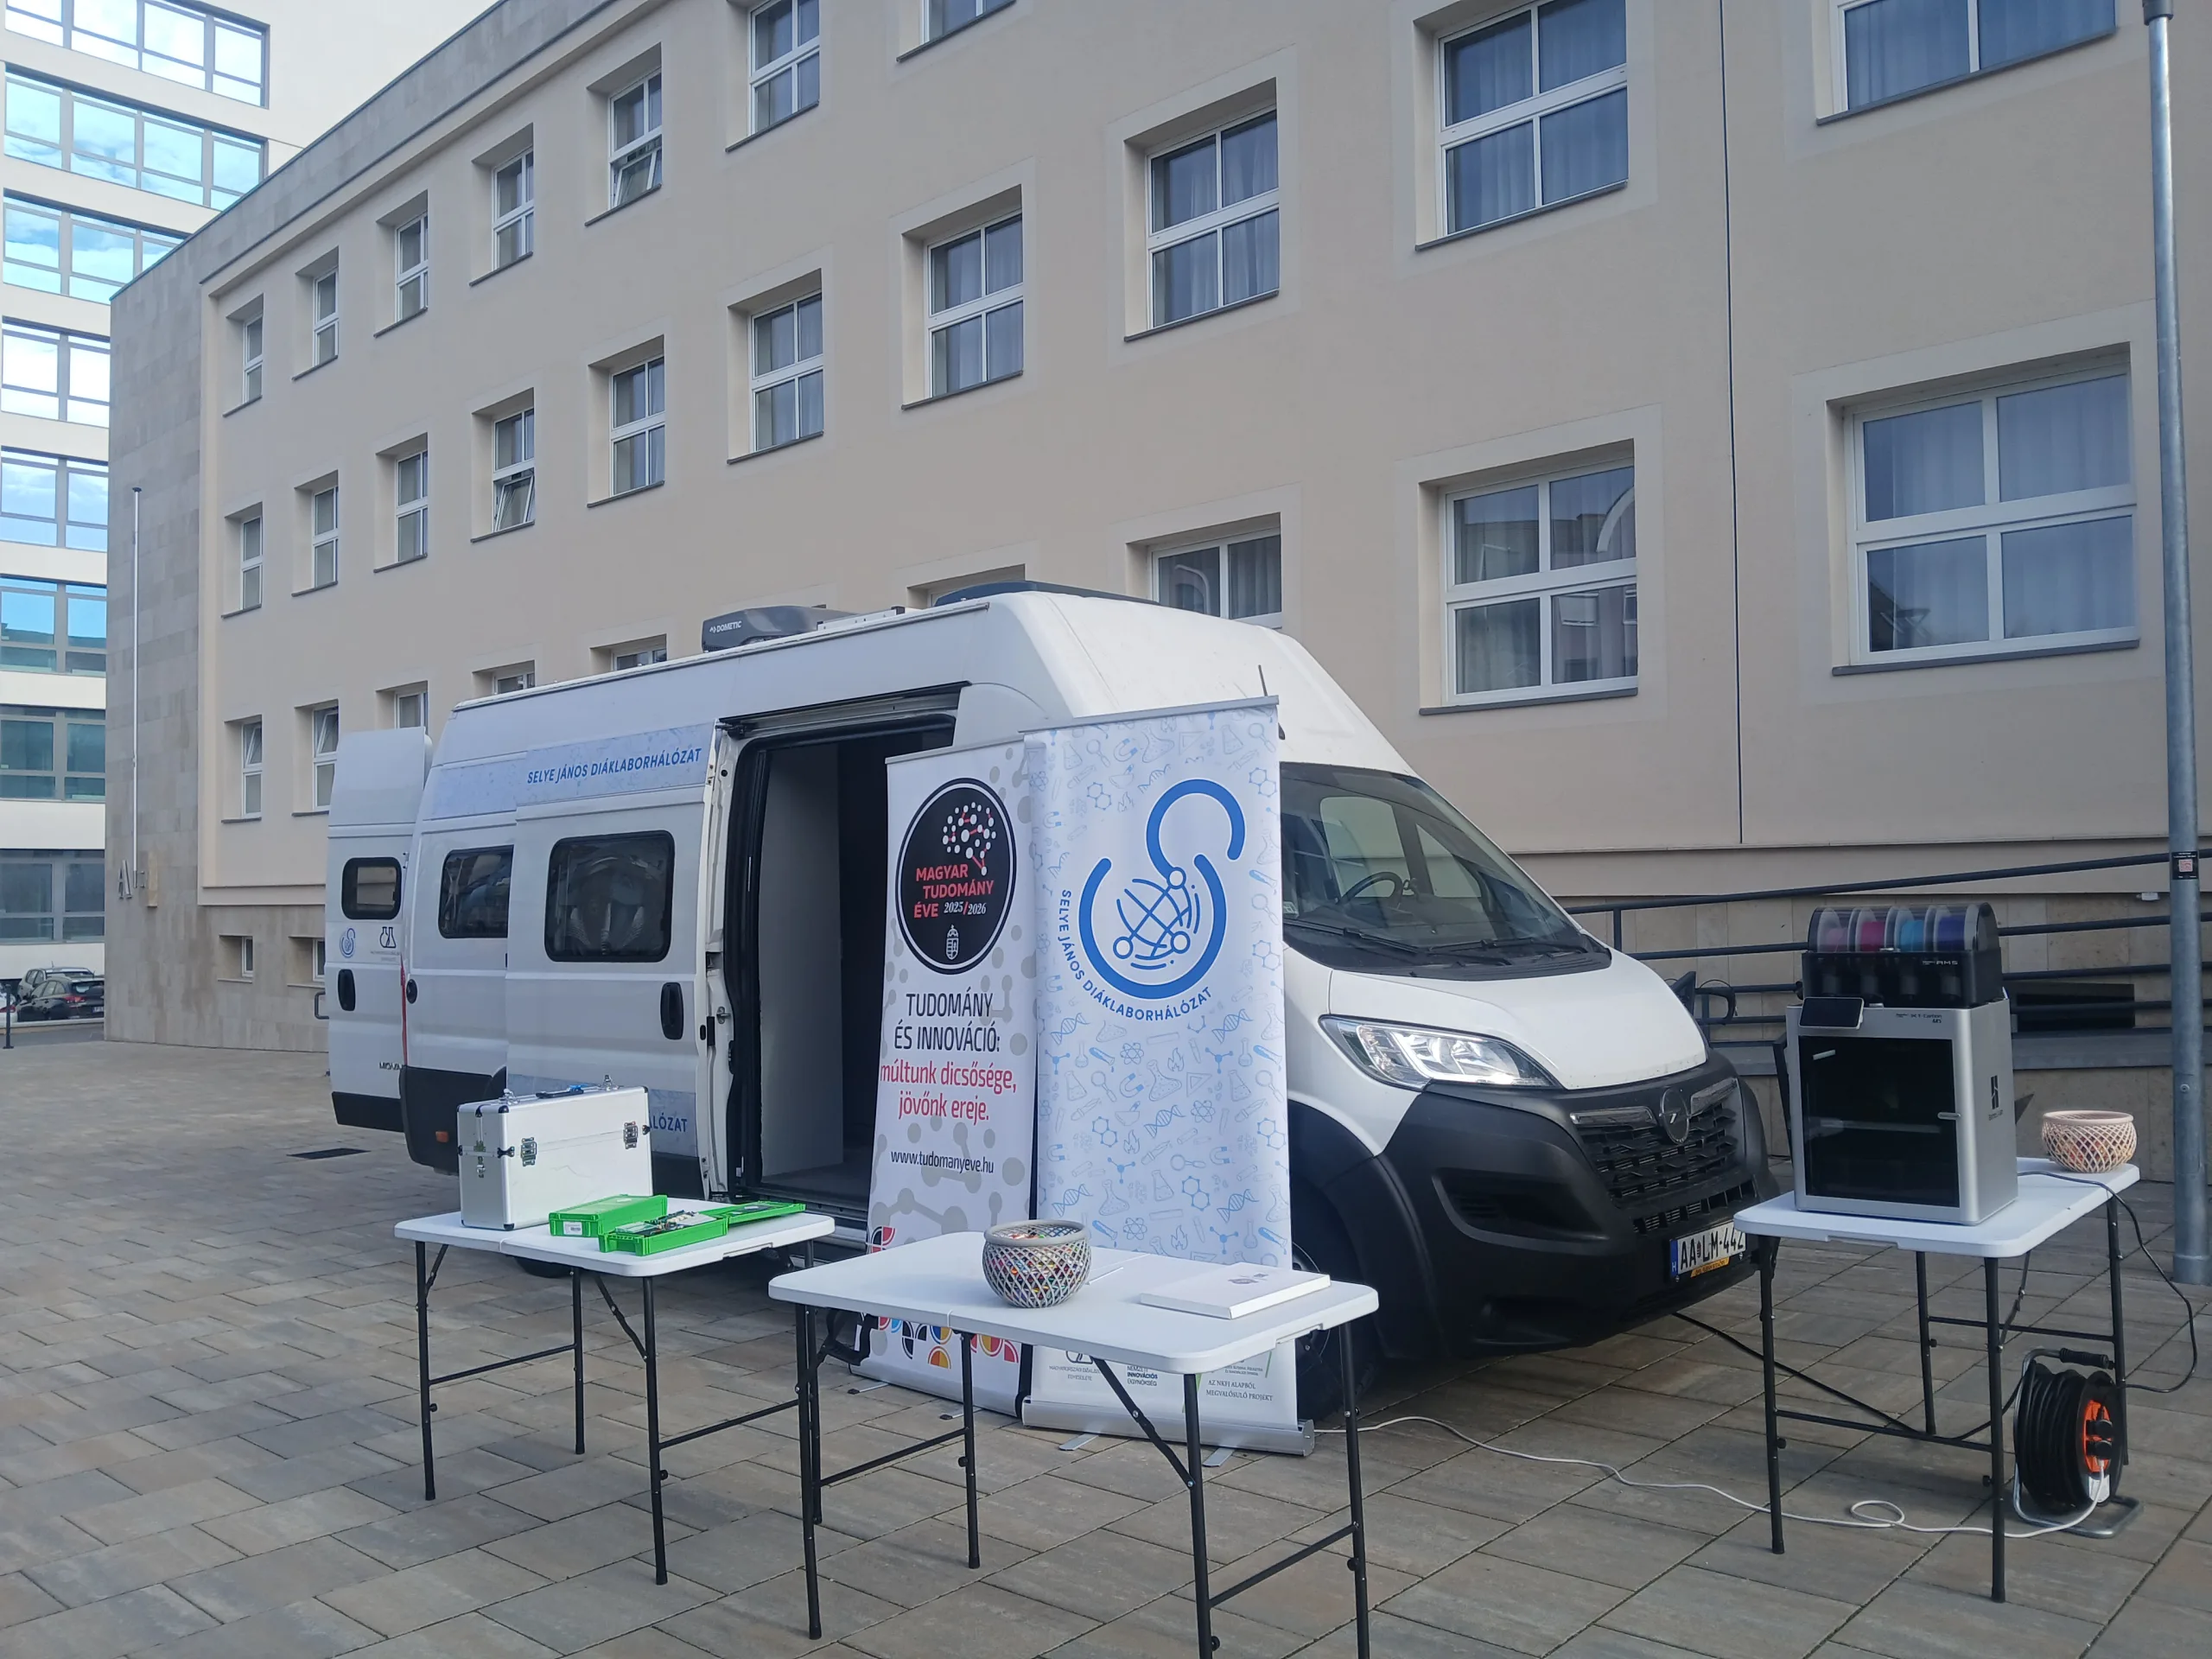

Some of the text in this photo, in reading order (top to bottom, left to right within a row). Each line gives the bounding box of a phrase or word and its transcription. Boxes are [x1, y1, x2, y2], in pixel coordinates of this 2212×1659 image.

[716, 620, 742, 632] DOMETIC
[527, 747, 702, 784] SELYE JÁNOS DIÁKLABORHÁLÓZAT
[916, 863, 969, 881] MAGYAR
[923, 878, 995, 899] TUDOMÁNY
[913, 900, 987, 918] ÉVE 2025/2026
[1058, 889, 1212, 1021] SELYE JÁNOS DIÁKLABORHÁLÓZAT
[906, 986, 994, 1017] TUDOMÁNY
[894, 1019, 1001, 1052] ÉS INNOVÁCIÓ:
[880, 1058, 1017, 1095] múltunk dicsősége,
[898, 1090, 989, 1126] jövőnk ereje.
[890, 1150, 995, 1174] www.tudomanyeve.hu
[1680, 1238, 1697, 1270] AA
[1127, 1371, 1159, 1380] INNOVÁCIÓS
[1231, 1381, 1256, 1389] ALAPBÓL
[1205, 1389, 1274, 1402] MEGVALÓSULÓ PROJEKT
